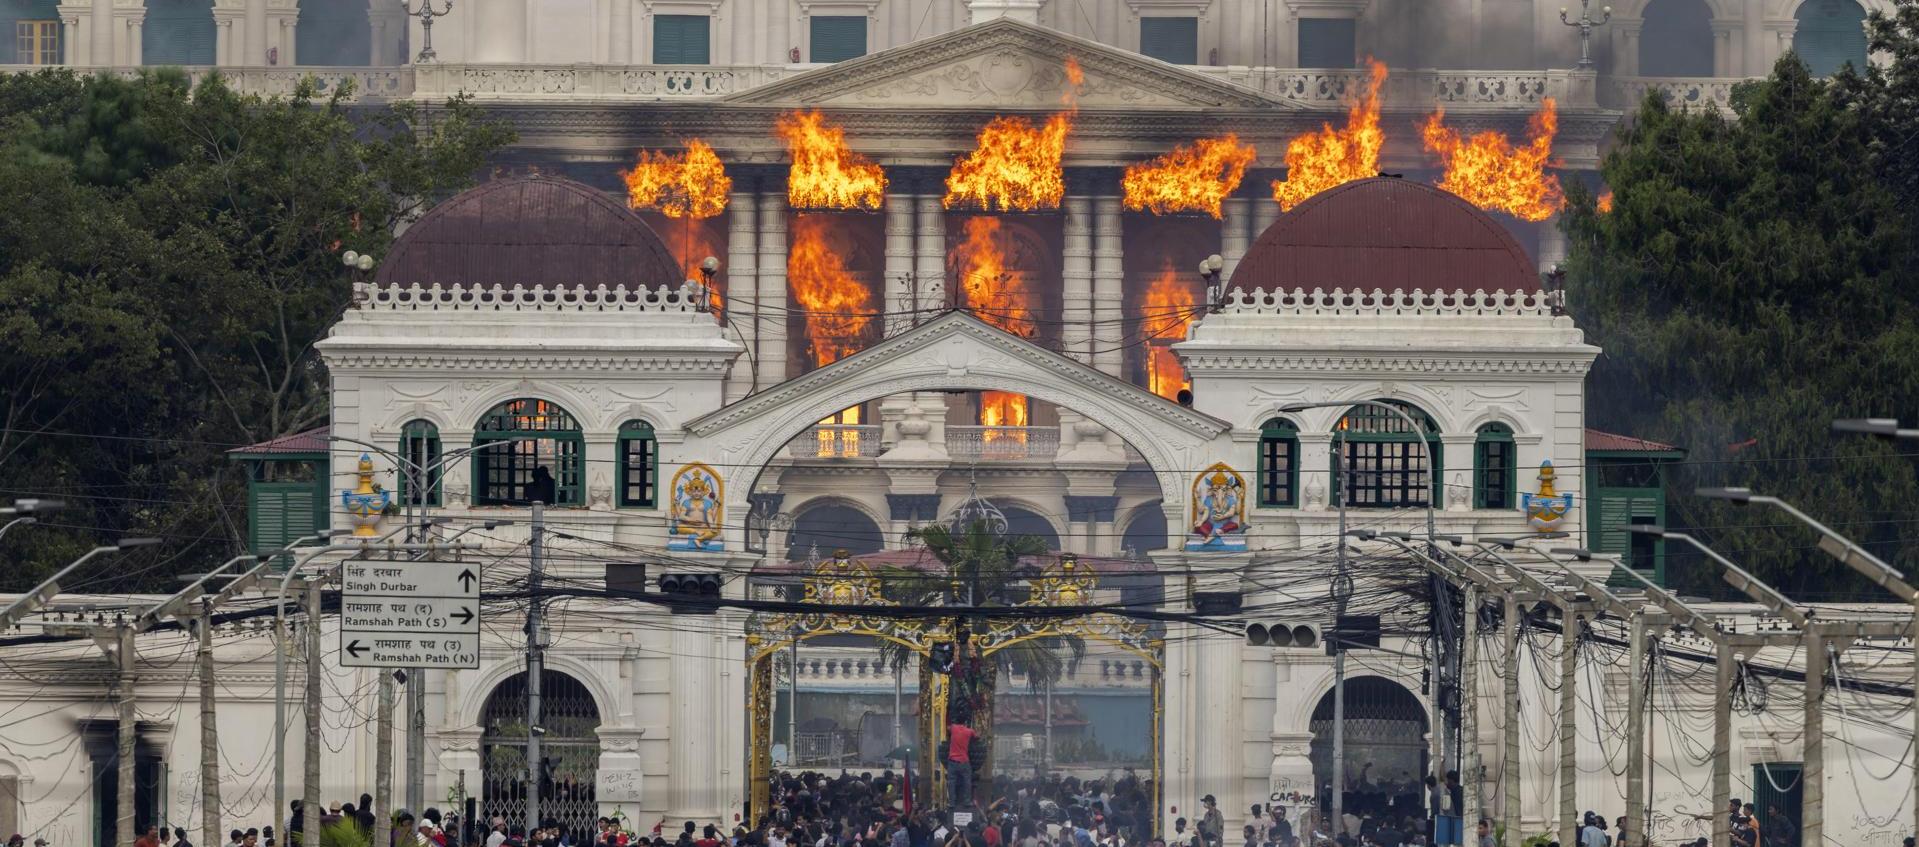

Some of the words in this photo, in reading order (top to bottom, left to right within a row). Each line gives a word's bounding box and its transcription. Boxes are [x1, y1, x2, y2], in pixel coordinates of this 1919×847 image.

[347, 565, 366, 577] सिंह
[373, 568, 403, 577] दरबार
[346, 582, 376, 592] Singh
[381, 582, 417, 591] Durbar
[346, 603, 383, 613] रामशाह
[391, 604, 407, 612] पथ
[415, 604, 433, 616] (द)
[345, 616, 393, 626] Ramshah
[398, 617, 422, 626] Path
[374, 639, 412, 649] रामशाह
[420, 640, 436, 649] पथ
[444, 640, 461, 652] (उ)
[373, 652, 421, 662] Ramshah
[426, 654, 449, 663] Path
